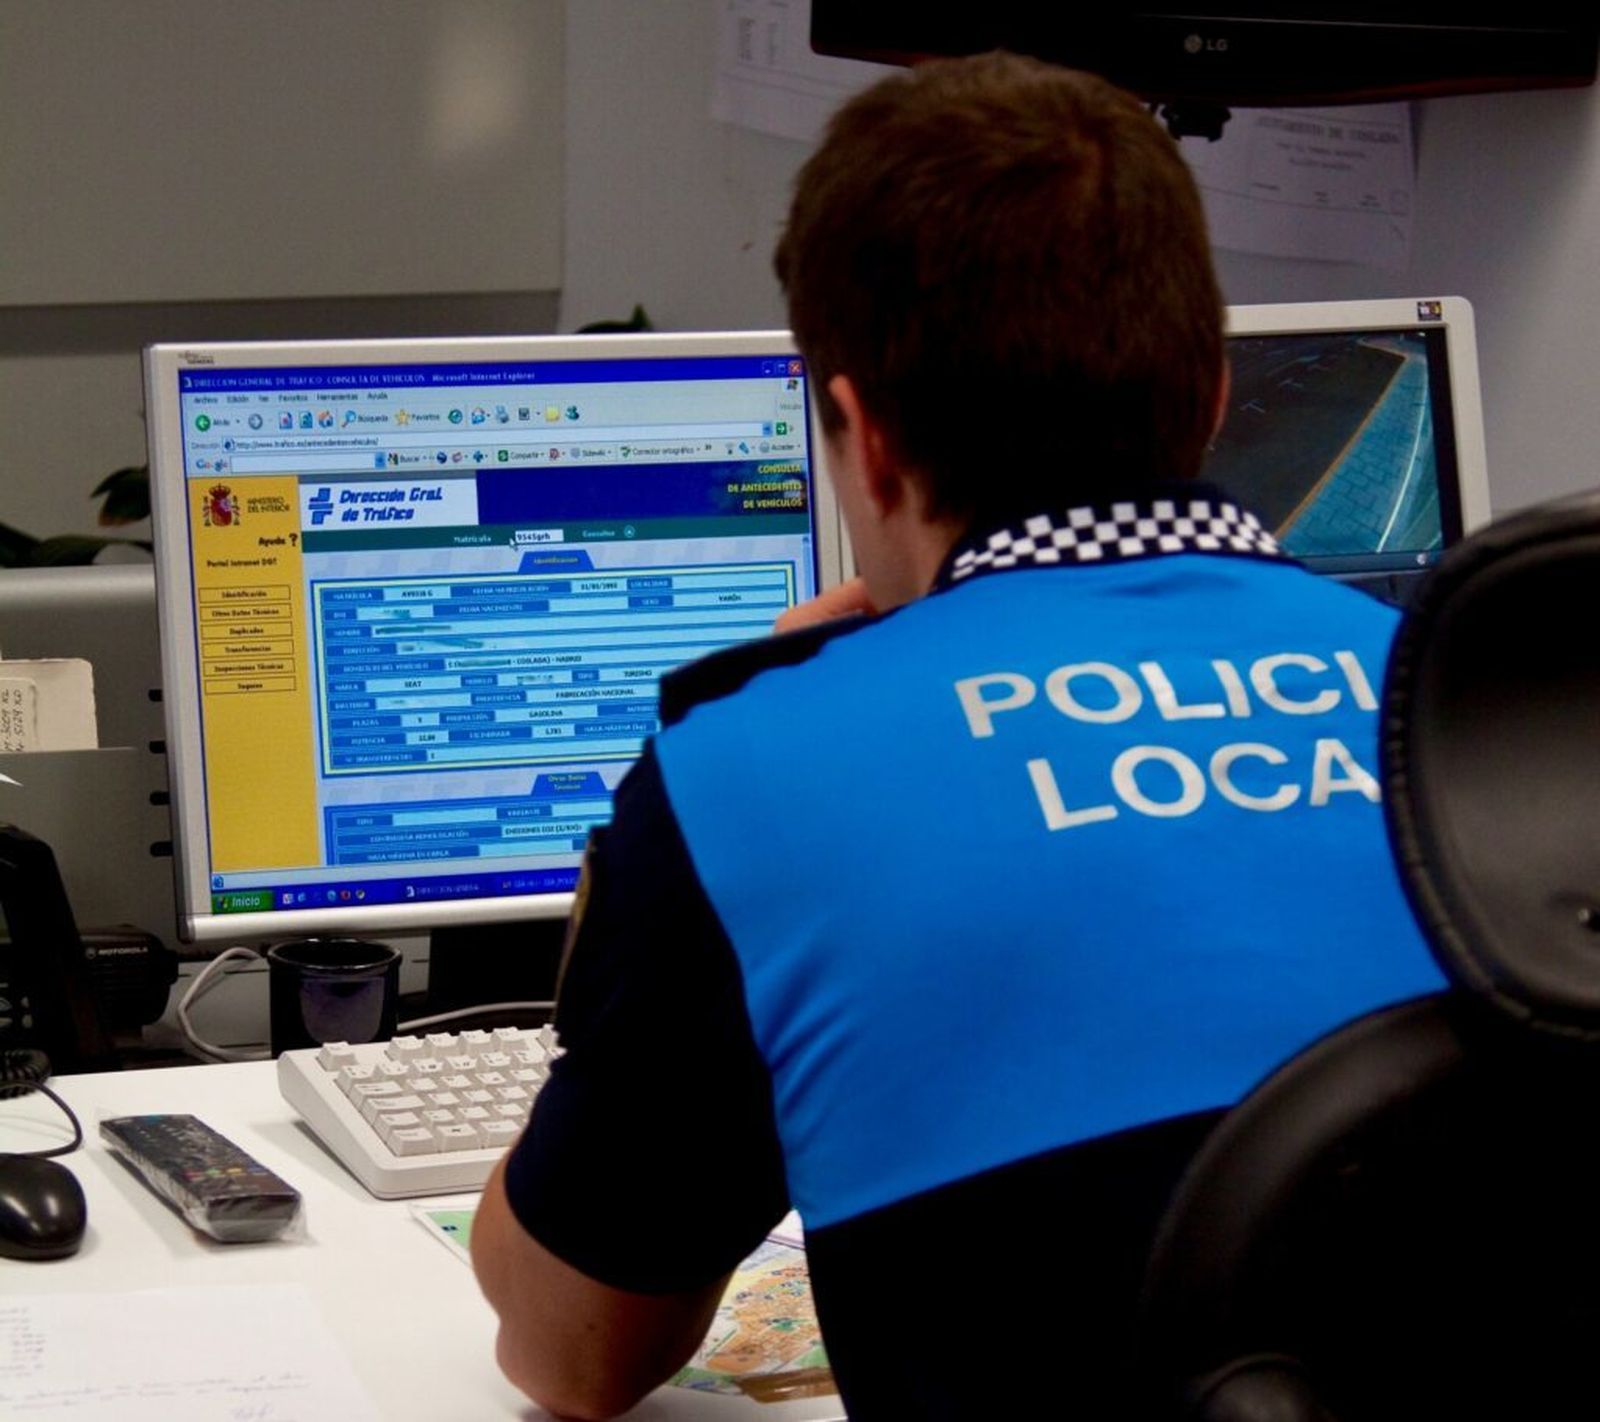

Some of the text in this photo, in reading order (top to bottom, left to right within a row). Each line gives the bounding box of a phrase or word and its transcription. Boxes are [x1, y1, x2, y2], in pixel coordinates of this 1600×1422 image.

[1206, 38, 1228, 51] LG
[757, 463, 801, 474] CONSULTA
[727, 483, 739, 493] DE
[743, 499, 755, 509] DE
[341, 507, 360, 522] de
[258, 532, 298, 547] Ayuda ?
[953, 650, 1379, 738] POLICI
[1026, 738, 1381, 832] LOCA
[231, 895, 260, 908] Inicio
